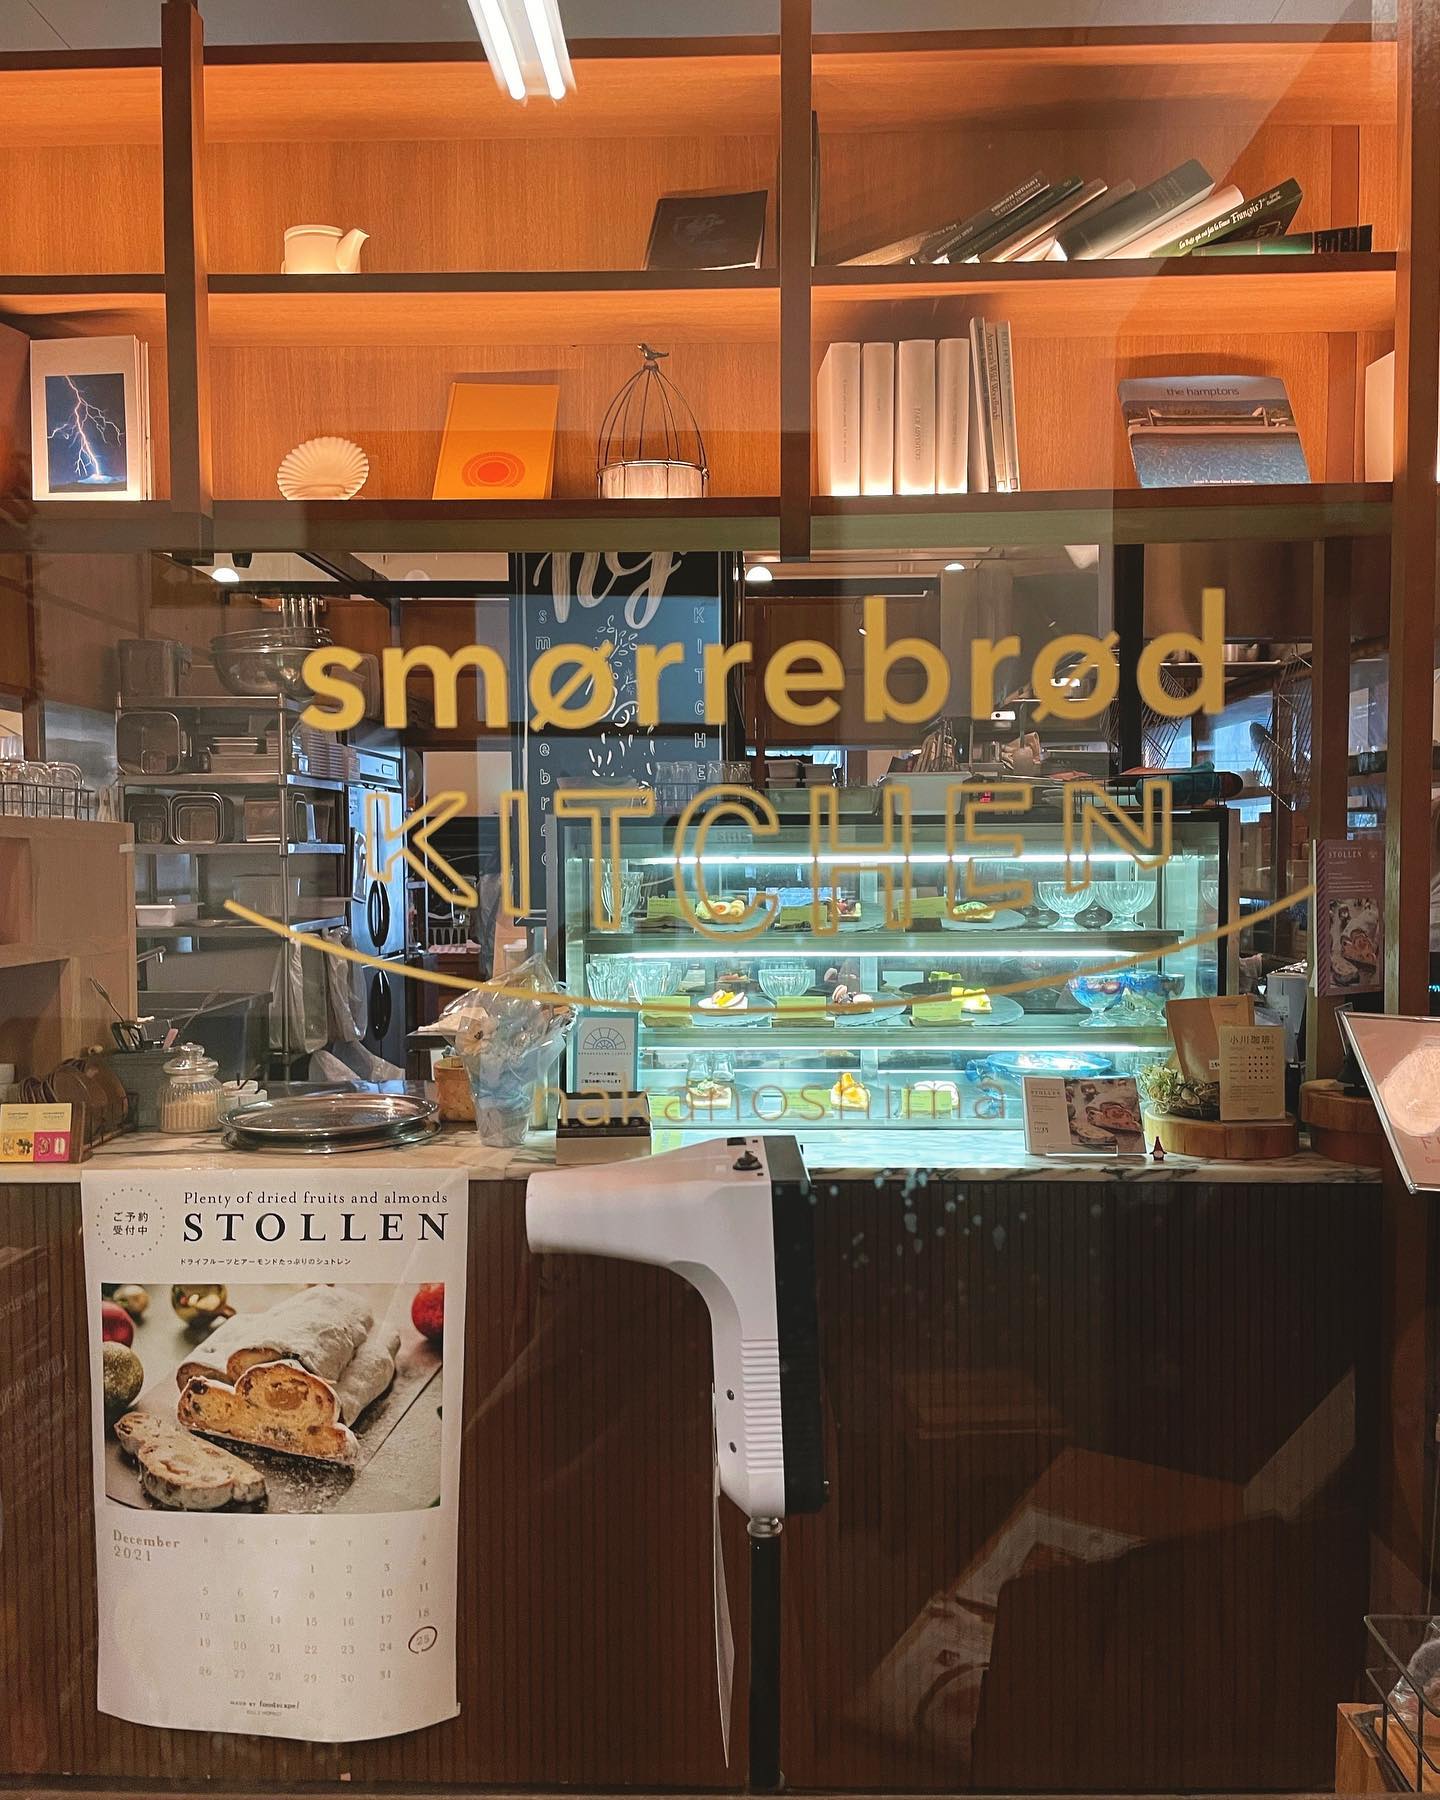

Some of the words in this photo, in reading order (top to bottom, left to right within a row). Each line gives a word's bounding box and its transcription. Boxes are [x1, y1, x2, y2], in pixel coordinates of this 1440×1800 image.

[1230, 202, 1259, 224] François
[1166, 388, 1184, 396] the
[1187, 388, 1239, 396] hamptons
[300, 588, 1226, 732] smørrebrød
[363, 781, 1172, 943] KITCHEN
[533, 1072, 1007, 1126] nakanoshima
[184, 1191, 231, 1208] Plenty
[236, 1191, 253, 1203] of
[257, 1191, 297, 1203] dried
[304, 1191, 345, 1204] fruits
[351, 1191, 378, 1204] and
[384, 1191, 448, 1204] almonds
[112, 1211, 149, 1223] ご予約
[112, 1224, 149, 1236] 受付中
[183, 1212, 449, 1242] STOLLEN
[180, 1258, 351, 1266] ドライフルーツとアーモンドたっぷりのシュトレン
[113, 1529, 180, 1548] December
[114, 1546, 152, 1561] 2021
[346, 1564, 352, 1573] 2
[384, 1563, 390, 1572] 3
[272, 1590, 279, 1599] 7
[345, 1591, 352, 1600] 9
[380, 1588, 393, 1598] 10
[419, 1582, 429, 1592] 11
[199, 1612, 210, 1621] 12
[234, 1613, 246, 1623] 13
[306, 1617, 317, 1626] 15
[342, 1617, 354, 1626] 16
[380, 1615, 392, 1624] 17
[418, 1609, 430, 1618] 18
[270, 1644, 280, 1653] 21
[304, 1646, 318, 1655] 22
[341, 1645, 354, 1655] 23
[379, 1642, 392, 1651] 24
[416, 1635, 430, 1645] 25
[304, 1674, 317, 1683] 29
[341, 1674, 354, 1683] 30
[379, 1670, 391, 1680] 31
